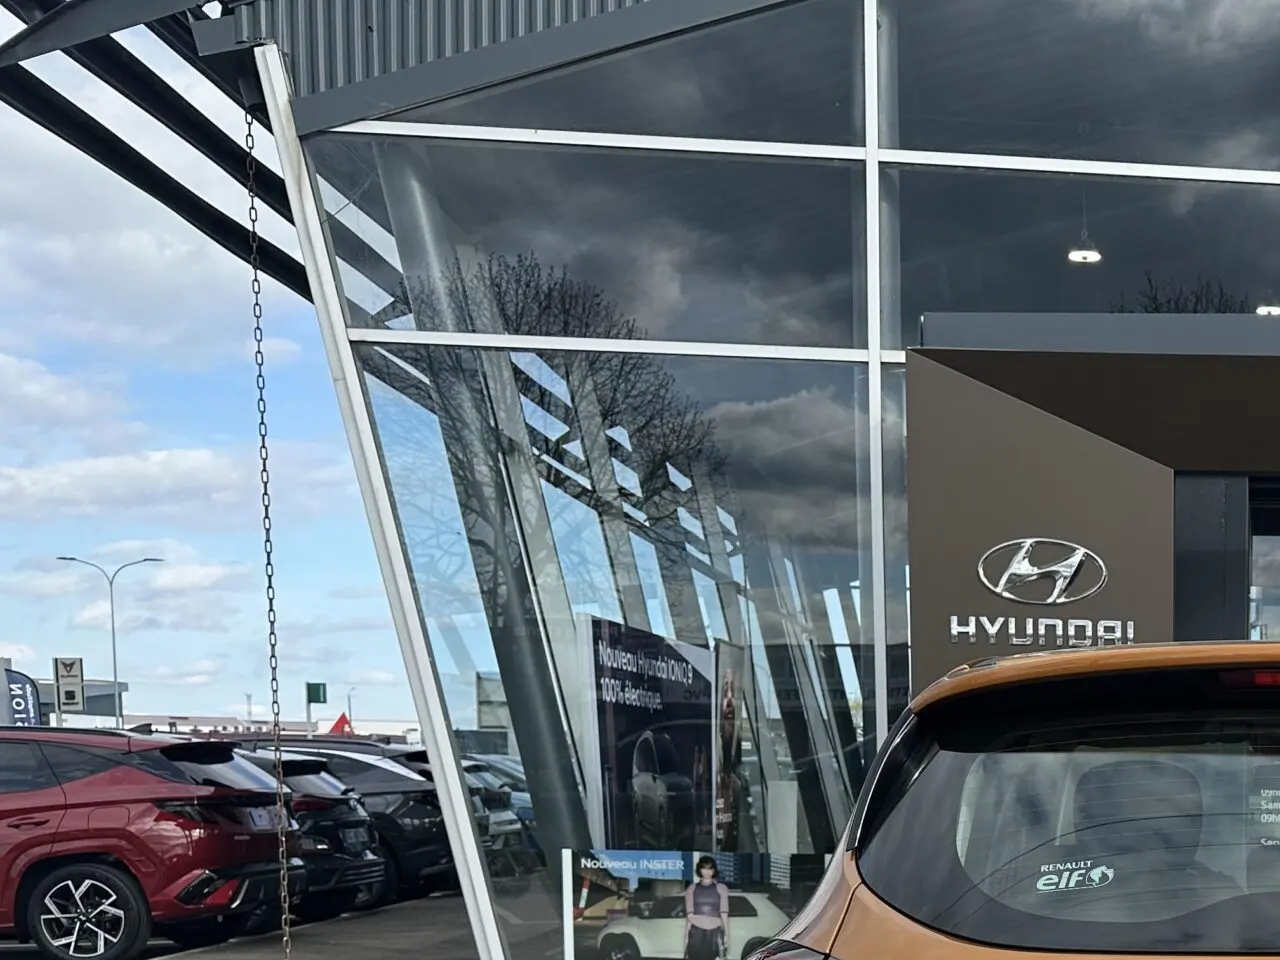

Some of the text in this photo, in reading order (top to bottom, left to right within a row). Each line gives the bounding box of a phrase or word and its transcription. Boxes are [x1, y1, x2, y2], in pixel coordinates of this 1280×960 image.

[949, 615, 1135, 647] HYUNDAI
[598, 639, 693, 687] Nouveau Hyundai IONIQ 9
[600, 677, 624, 705] 100%
[580, 858, 685, 870] Nouveau INSTER
[1040, 860, 1094, 873] RENAULT
[1036, 869, 1086, 891] elf
